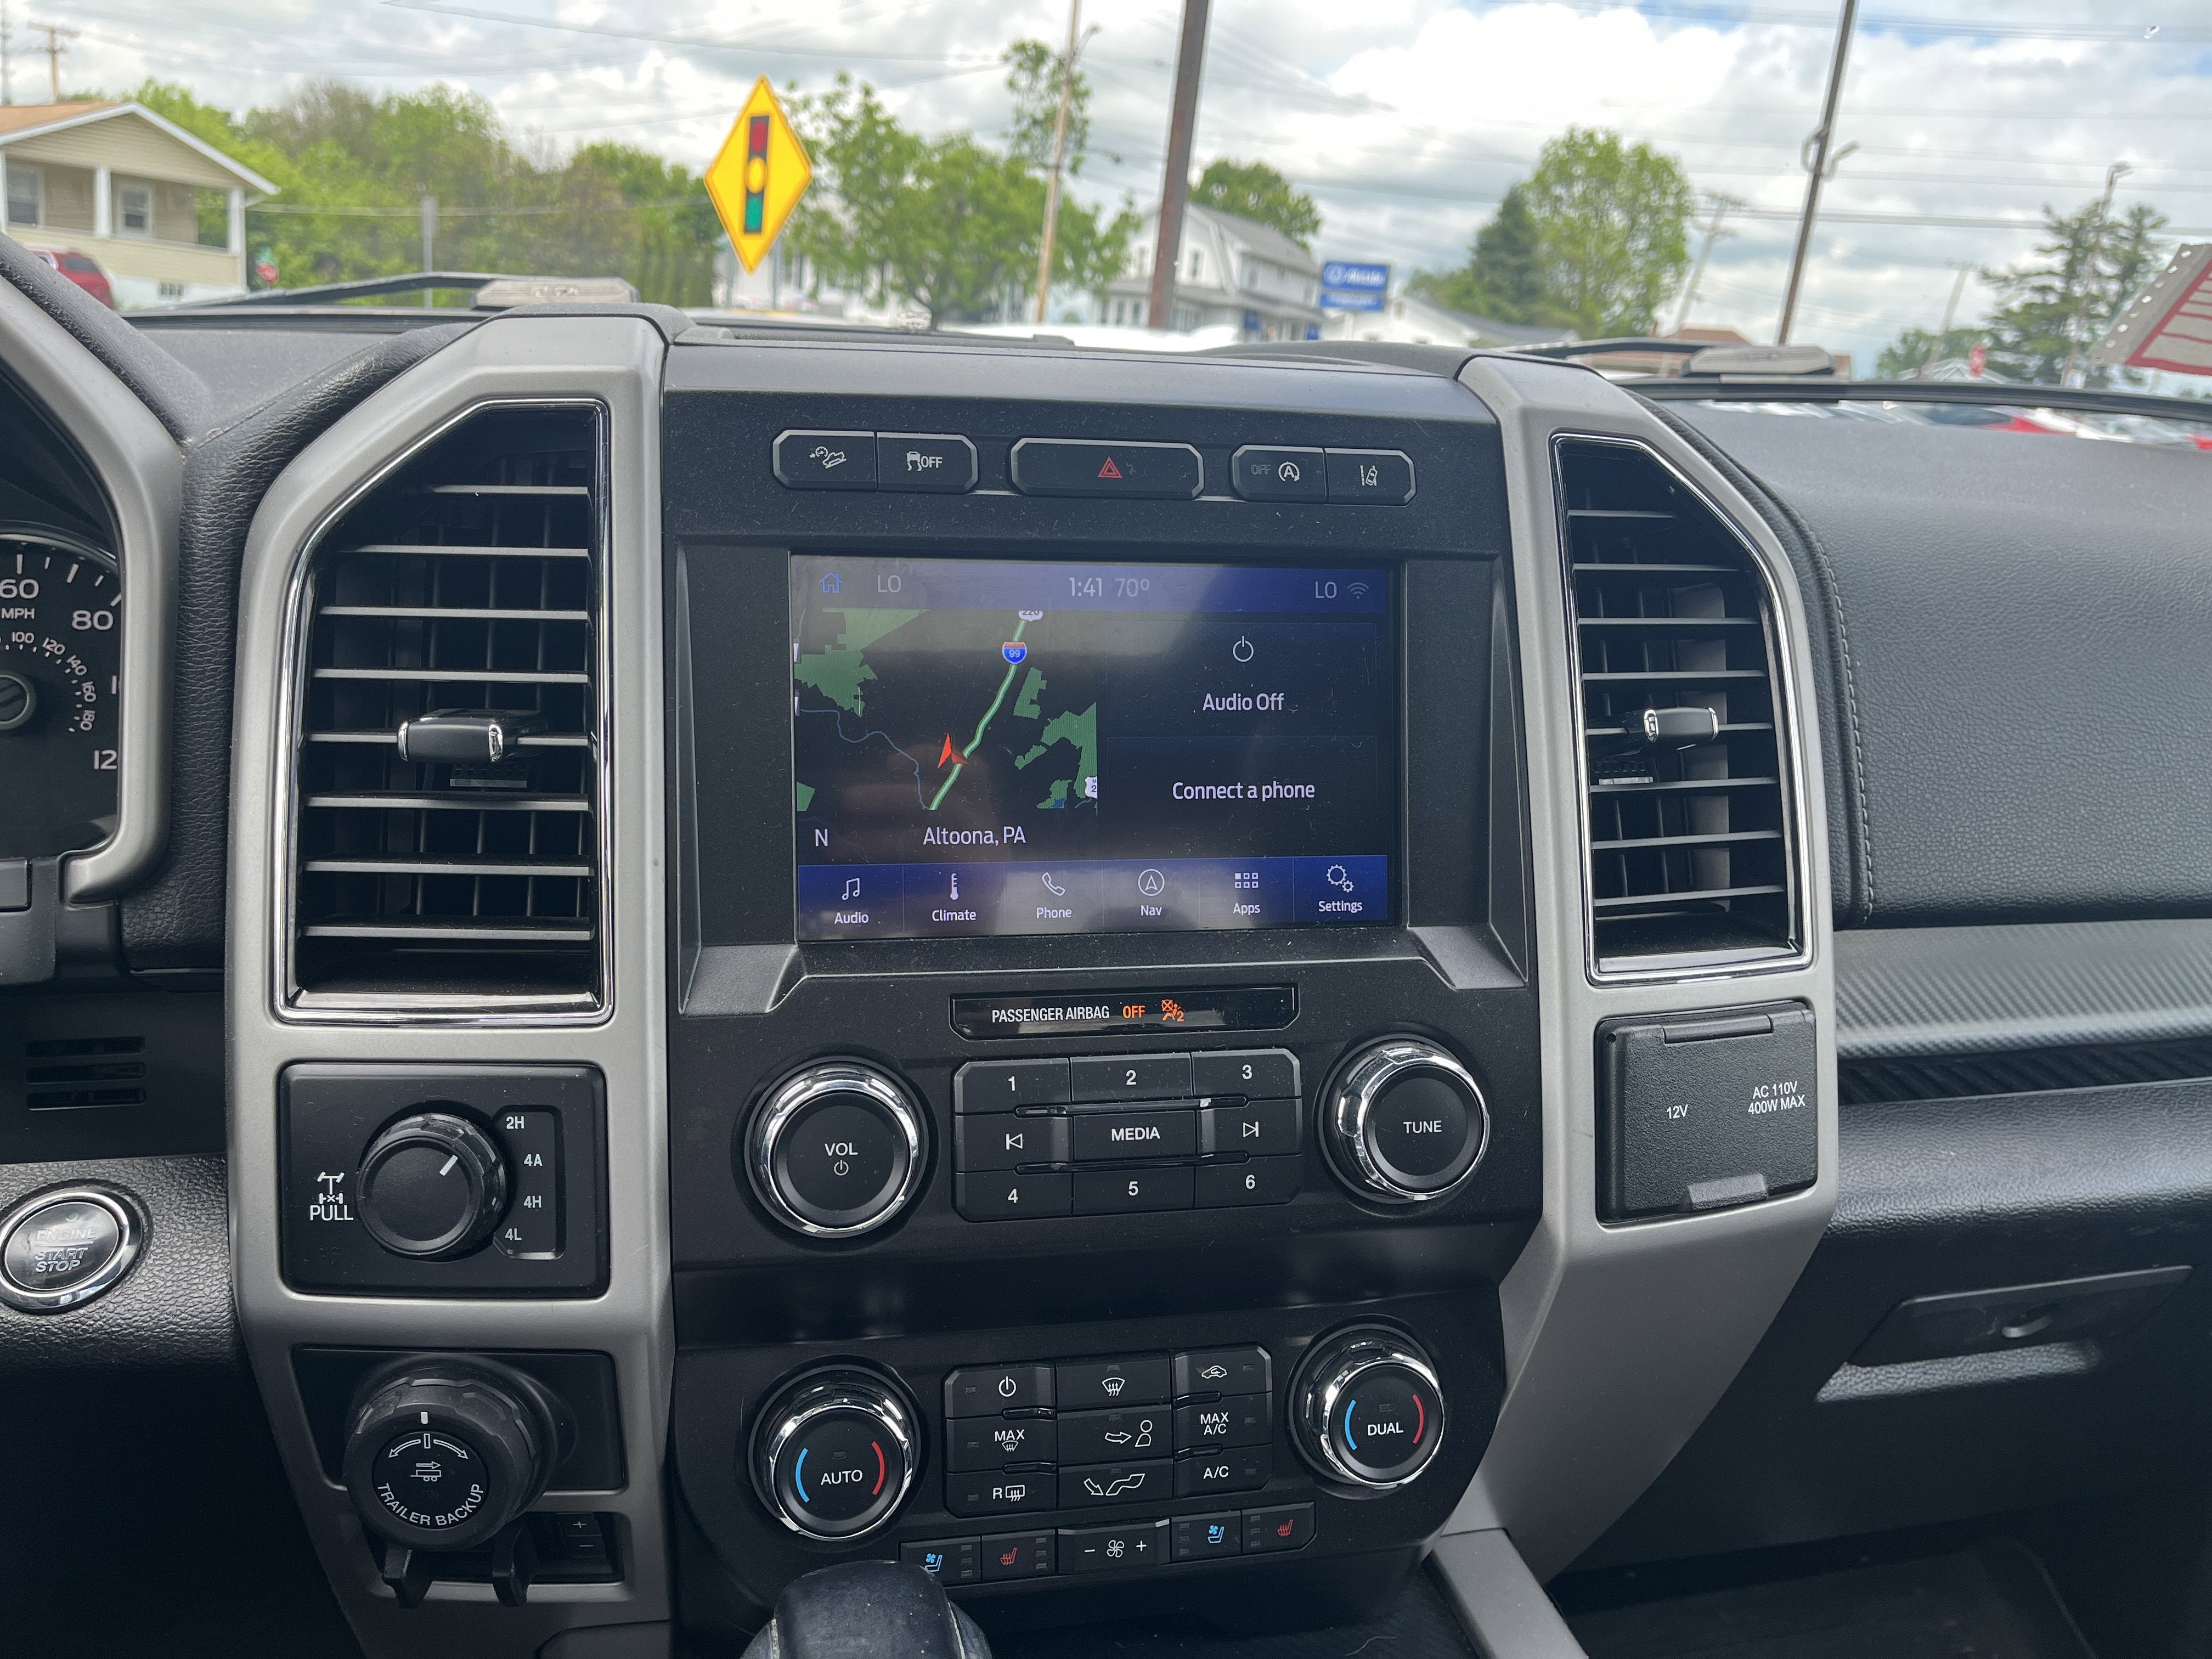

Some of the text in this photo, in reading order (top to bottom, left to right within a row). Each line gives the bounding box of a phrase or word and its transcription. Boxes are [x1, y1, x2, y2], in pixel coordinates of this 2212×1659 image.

[921, 455, 943, 469] OFF
[0, 578, 41, 600] 60
[877, 574, 901, 593] LO
[1069, 577, 1103, 597] 1:41
[1315, 581, 1337, 599] LO
[1, 607, 35, 619] MPH
[72, 610, 114, 630] 80
[12, 631, 35, 644] 100
[42, 637, 65, 657] 120
[1008, 649, 1021, 659] 99
[65, 654, 87, 676] 140
[82, 681, 97, 702] 160
[1202, 692, 1284, 711] Audio Off
[78, 709, 95, 731] 180
[1172, 781, 1315, 802] Connect a phone
[815, 828, 828, 847] N
[923, 826, 1026, 847] Altoona, PA
[1036, 906, 1072, 919] Phone
[1141, 905, 1163, 916] Nav
[1233, 902, 1260, 916] Apps
[1318, 900, 1363, 913] Settings
[834, 911, 869, 924] Audio
[932, 909, 977, 921] Climate
[992, 1005, 1146, 1023] PASSENGER AIRBAG OFF
[1126, 1069, 1137, 1085] 2
[1242, 1064, 1252, 1080] 3
[1008, 1076, 1015, 1091] 1
[1752, 1080, 1800, 1100] AC 110V
[1666, 1104, 1688, 1119] 12V
[1748, 1093, 1805, 1115] 400W MAX
[506, 1116, 524, 1130] 2H
[1403, 1120, 1442, 1134] TUNE
[1111, 1126, 1161, 1141] MEDIA
[824, 1142, 859, 1156] VOL
[523, 1153, 543, 1167] 4A
[1128, 1181, 1139, 1196] 5
[1245, 1174, 1255, 1189] 6
[523, 1195, 541, 1208] 4H
[1008, 1188, 1019, 1204] 4
[310, 1204, 354, 1221] PULL
[36, 1227, 98, 1241] ENGINE
[505, 1228, 522, 1241] 4L
[35, 1247, 88, 1261] START
[35, 1260, 81, 1272] STOP
[1200, 1412, 1229, 1426] MAX
[995, 1429, 1025, 1443] MAX
[1204, 1423, 1227, 1436] A/C
[1368, 1422, 1404, 1436] DUAL
[821, 1469, 863, 1486] AUTO
[1203, 1465, 1229, 1480] A/C
[992, 1487, 1003, 1499] R
[377, 1482, 483, 1526] TRAILER BACKUP
